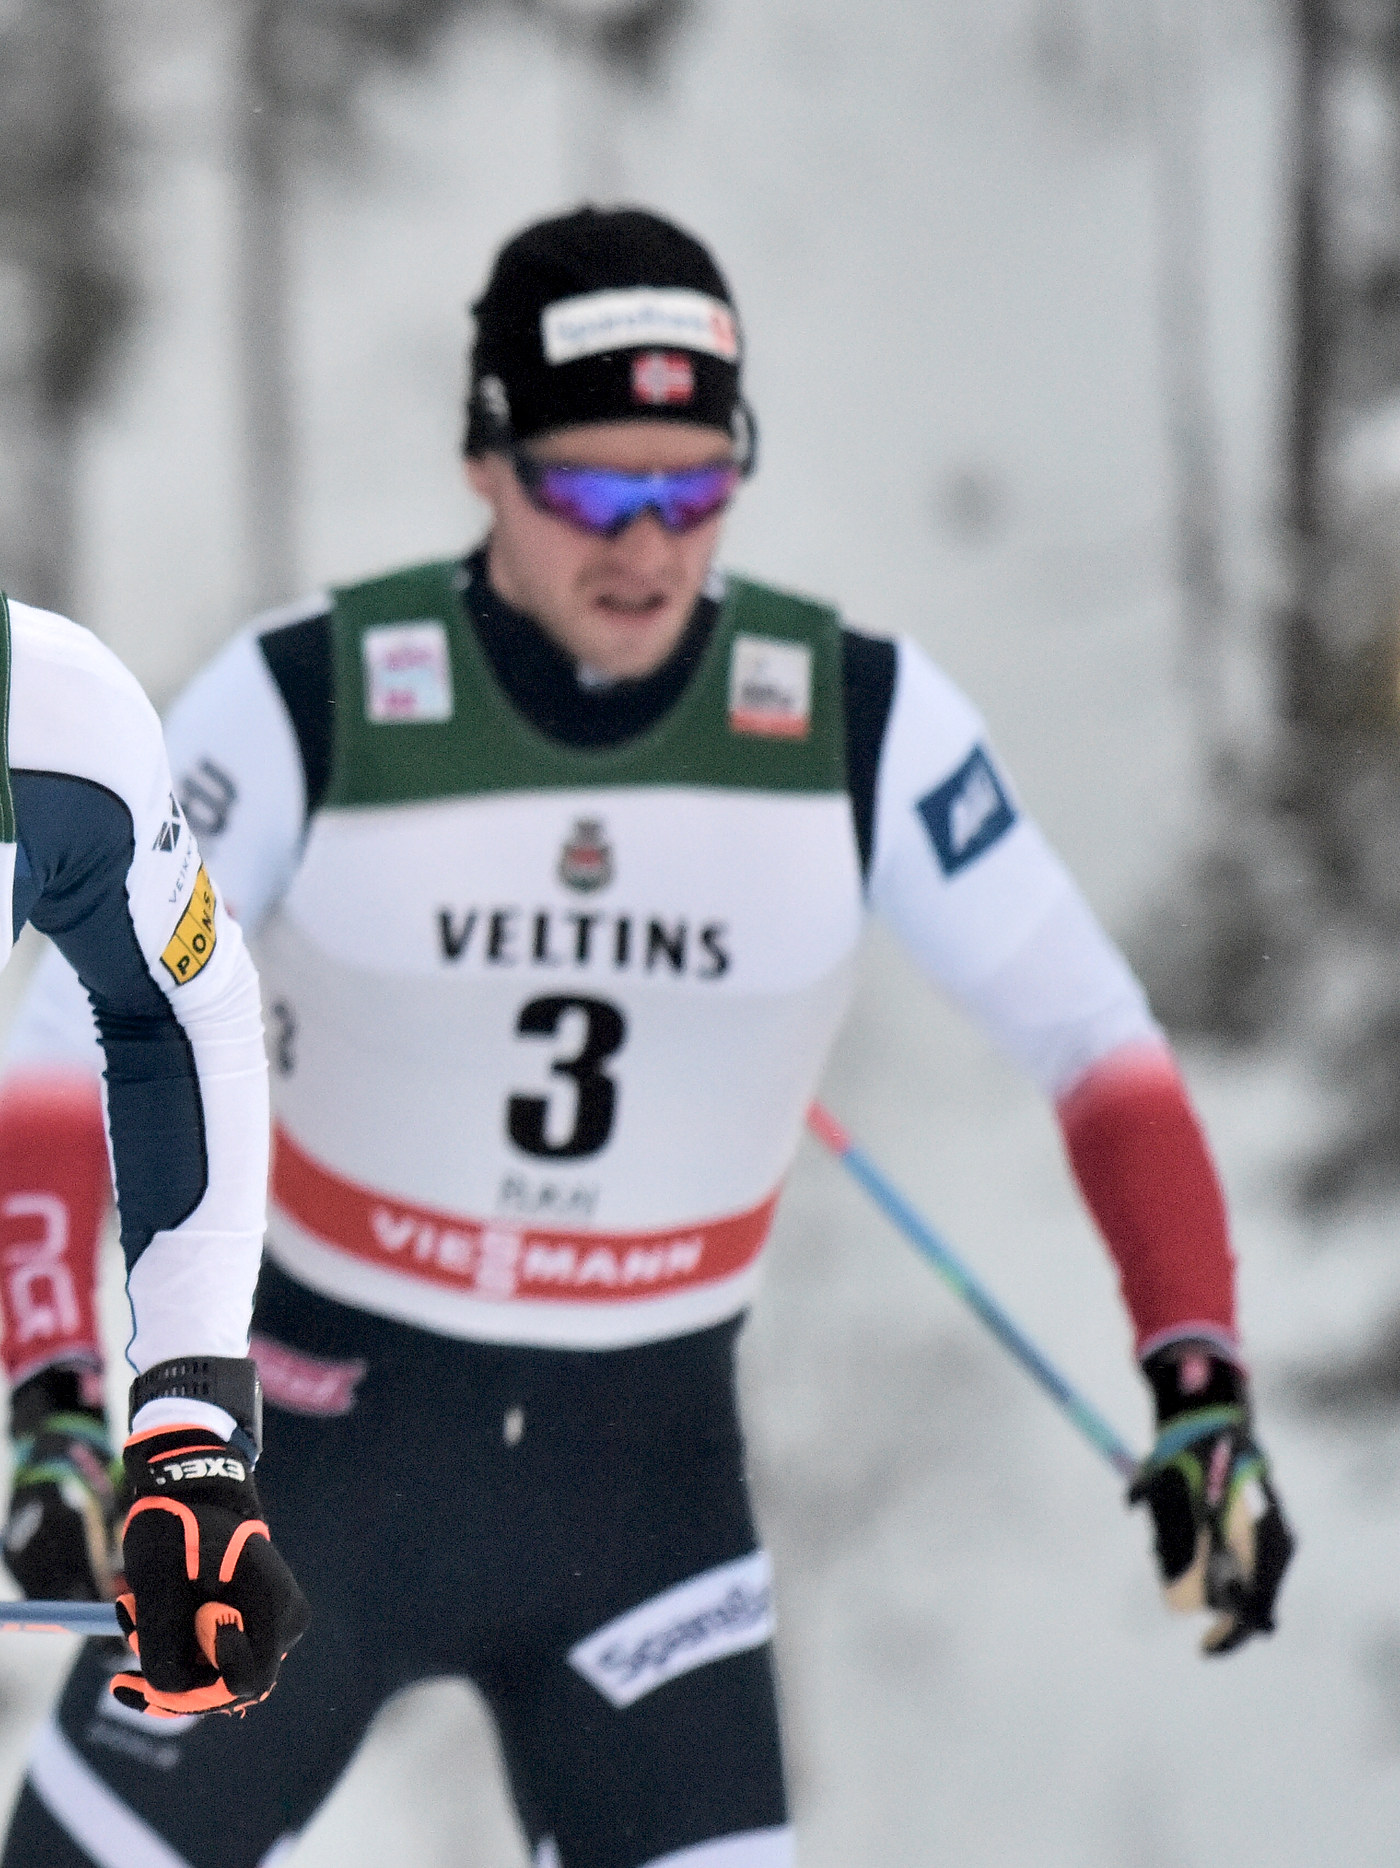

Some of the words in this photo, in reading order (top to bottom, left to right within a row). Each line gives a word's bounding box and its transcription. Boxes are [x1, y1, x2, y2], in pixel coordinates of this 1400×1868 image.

[436, 906, 732, 980] VELTINS
[507, 992, 628, 1161] 3
[164, 1457, 246, 1482] EXEL
